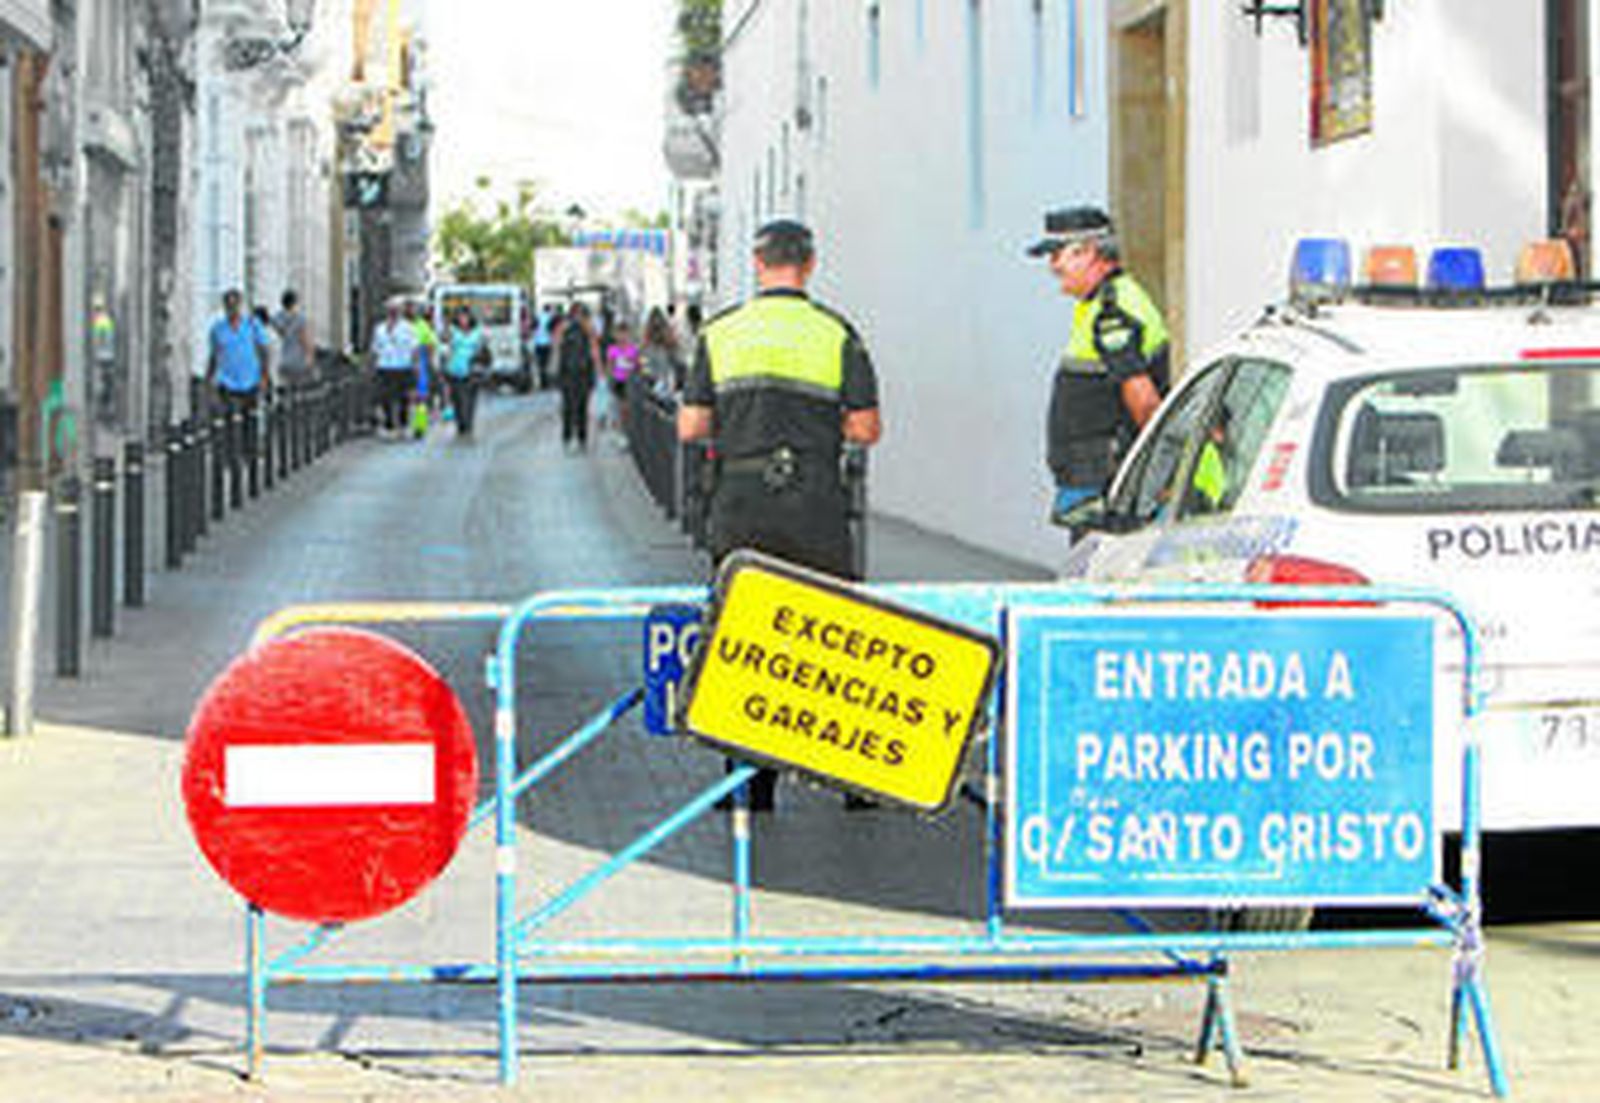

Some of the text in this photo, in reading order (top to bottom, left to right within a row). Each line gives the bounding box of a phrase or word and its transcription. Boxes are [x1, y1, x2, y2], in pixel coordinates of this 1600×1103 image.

[772, 606, 935, 679] EXCEPTO
[718, 637, 925, 725] URGENCIAS
[942, 709, 961, 735] Y
[1095, 650, 1355, 699] ENTRADA A
[743, 694, 906, 766] GARAJES
[1076, 731, 1376, 781] PARKING POR
[1258, 812, 1426, 862] CRISTO
